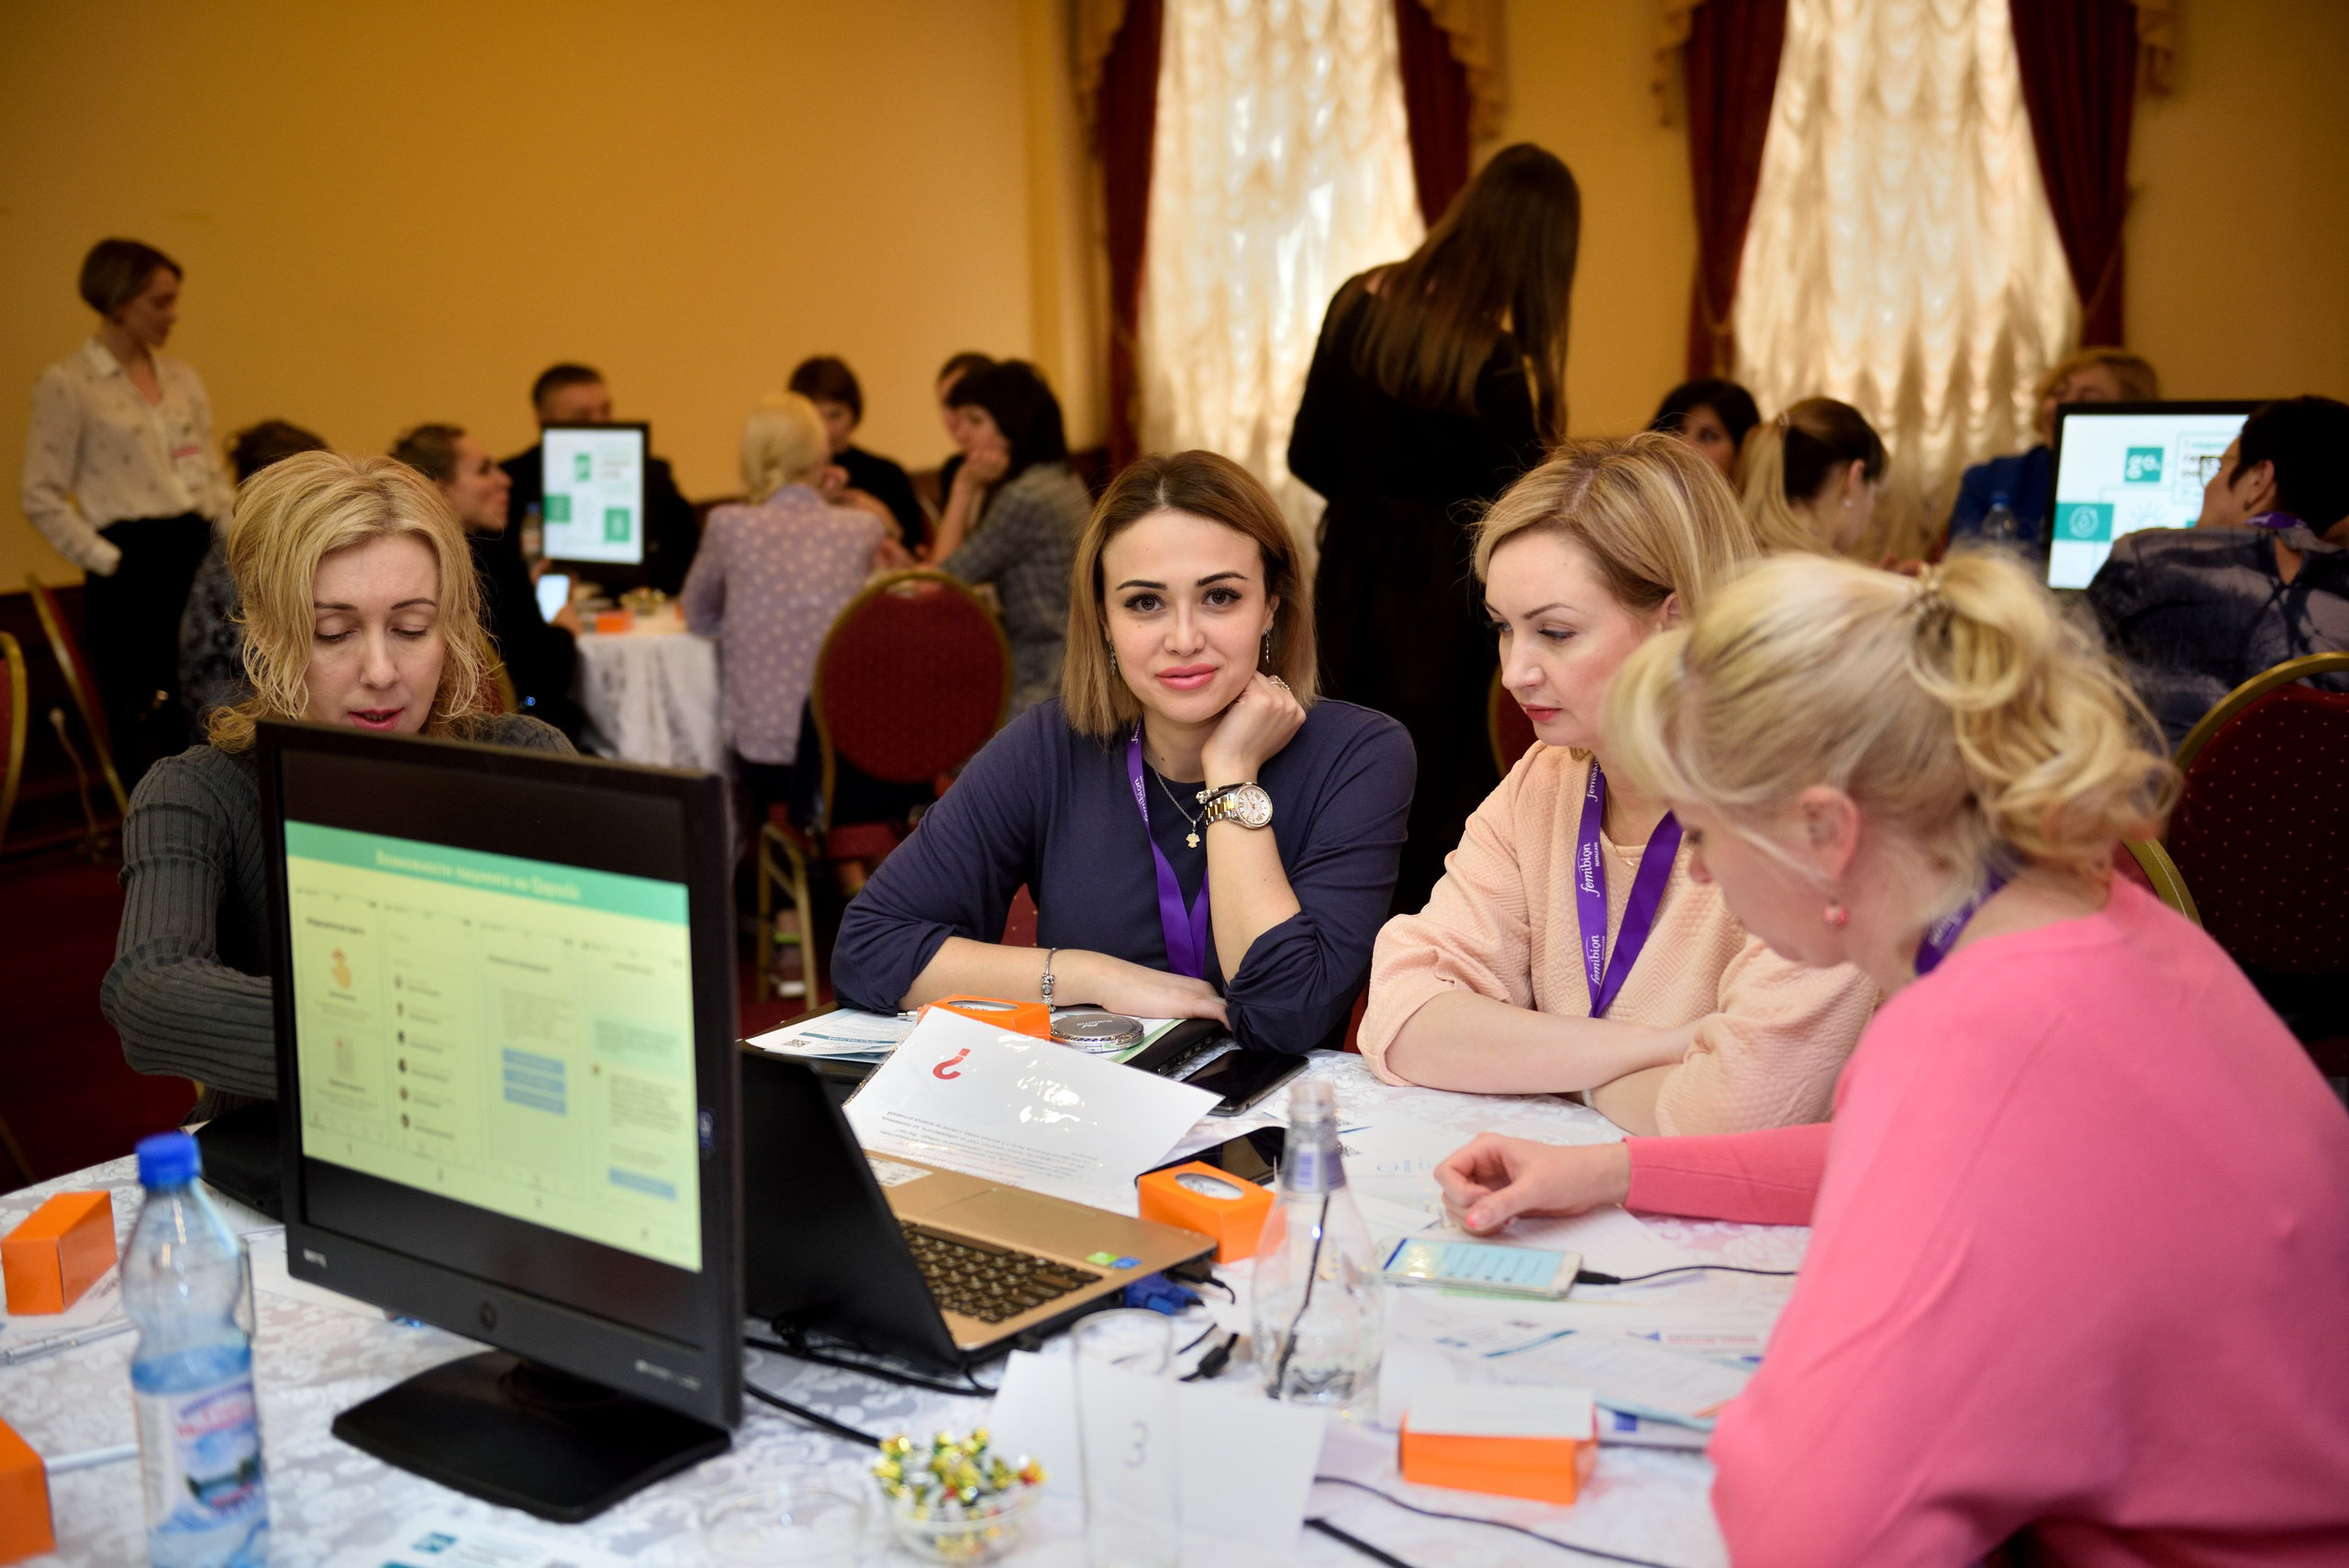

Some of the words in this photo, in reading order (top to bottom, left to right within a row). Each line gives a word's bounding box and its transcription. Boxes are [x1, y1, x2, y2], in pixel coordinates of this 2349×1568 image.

[1580, 841, 1600, 898] femibion
[1587, 933, 1601, 986] femibion
[1124, 1421, 1150, 1469] 3
